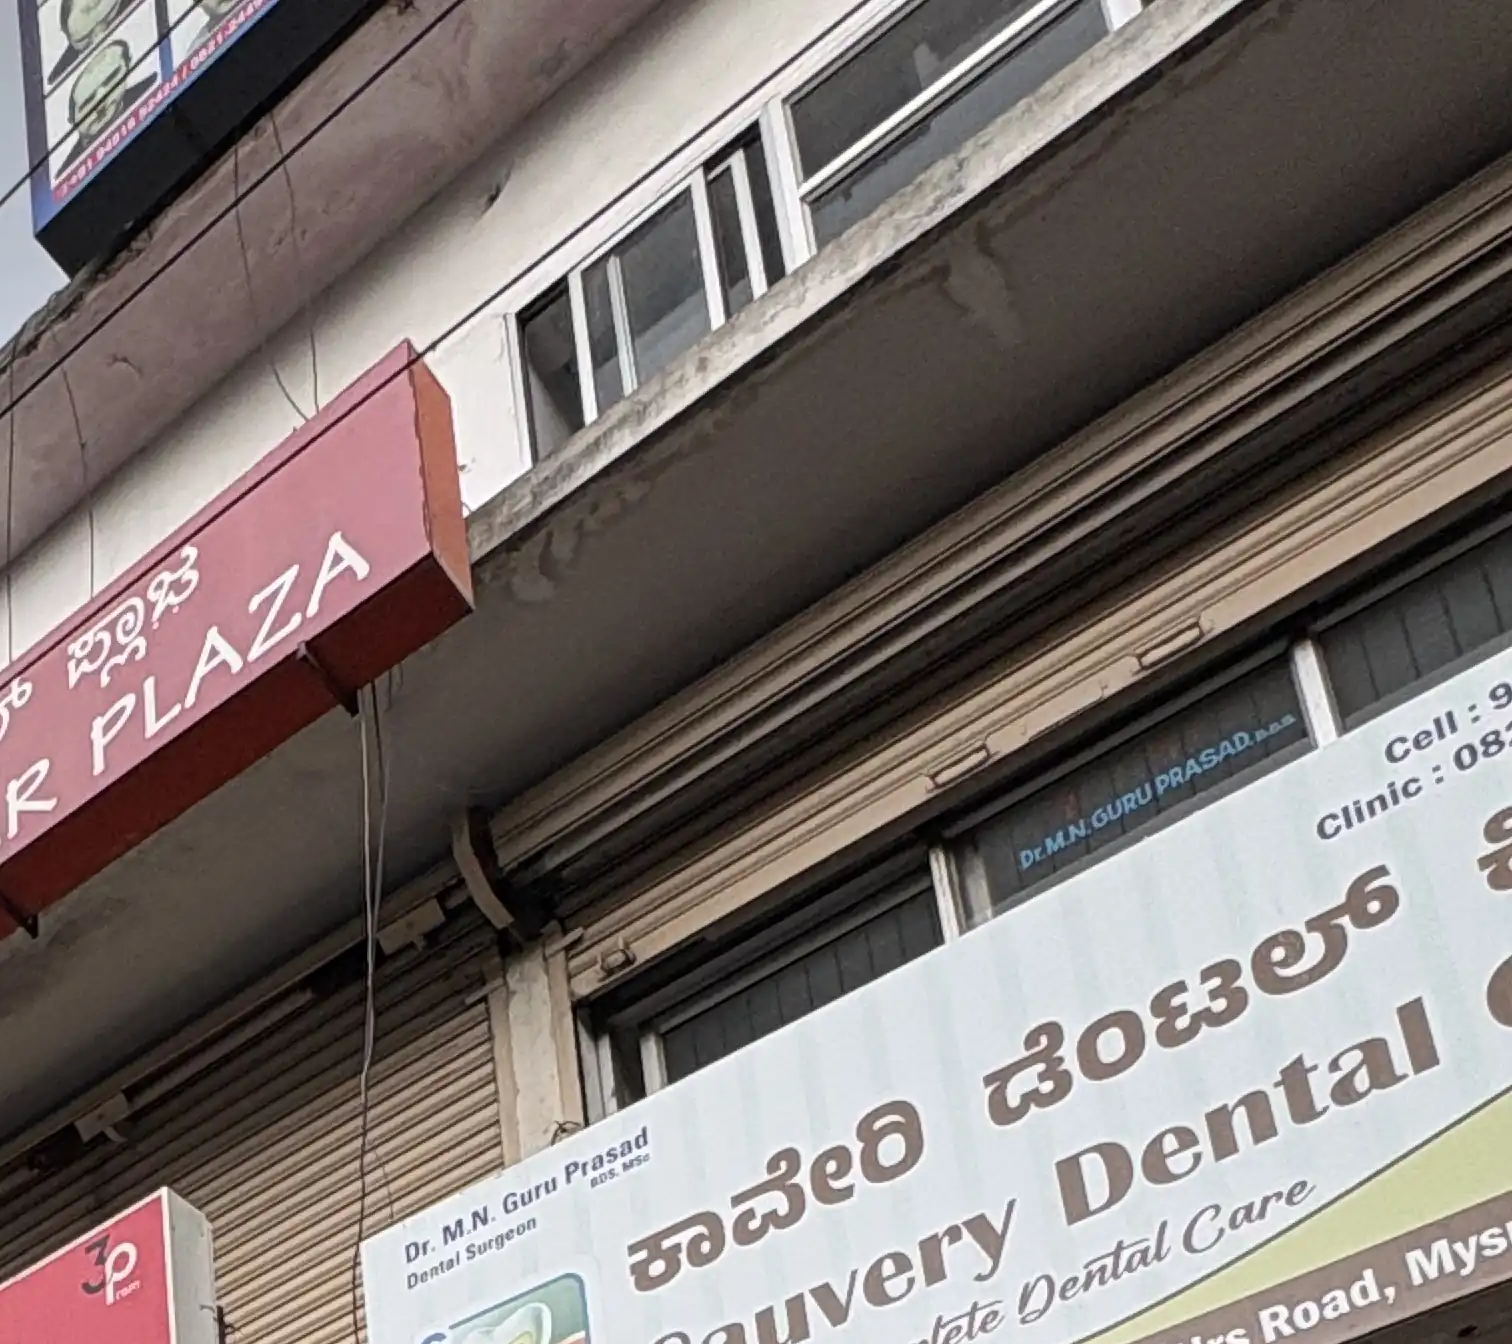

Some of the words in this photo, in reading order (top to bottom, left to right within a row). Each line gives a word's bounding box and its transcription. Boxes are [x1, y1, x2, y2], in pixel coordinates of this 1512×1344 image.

[91, 531, 370, 776] PLAZA
[1384, 710, 1458, 764] Cell
[1316, 777, 1423, 840] Clinic
[627, 1099, 924, 1292] ಕಾವೇರಿ
[982, 864, 1400, 1127] ಡೆಂಟಲ್
[1054, 996, 1440, 1226] Dental
[404, 1237, 436, 1264] Dr.
[441, 1205, 497, 1246] M.N.
[502, 1176, 558, 1215] Guru
[564, 1126, 649, 1186] Prasad
[406, 1252, 460, 1290] Dental
[465, 1216, 537, 1263] Surgeon
[1018, 1219, 1170, 1325] Dental
[1182, 1180, 1316, 1254] Care
[1258, 1268, 1396, 1344] Road,
